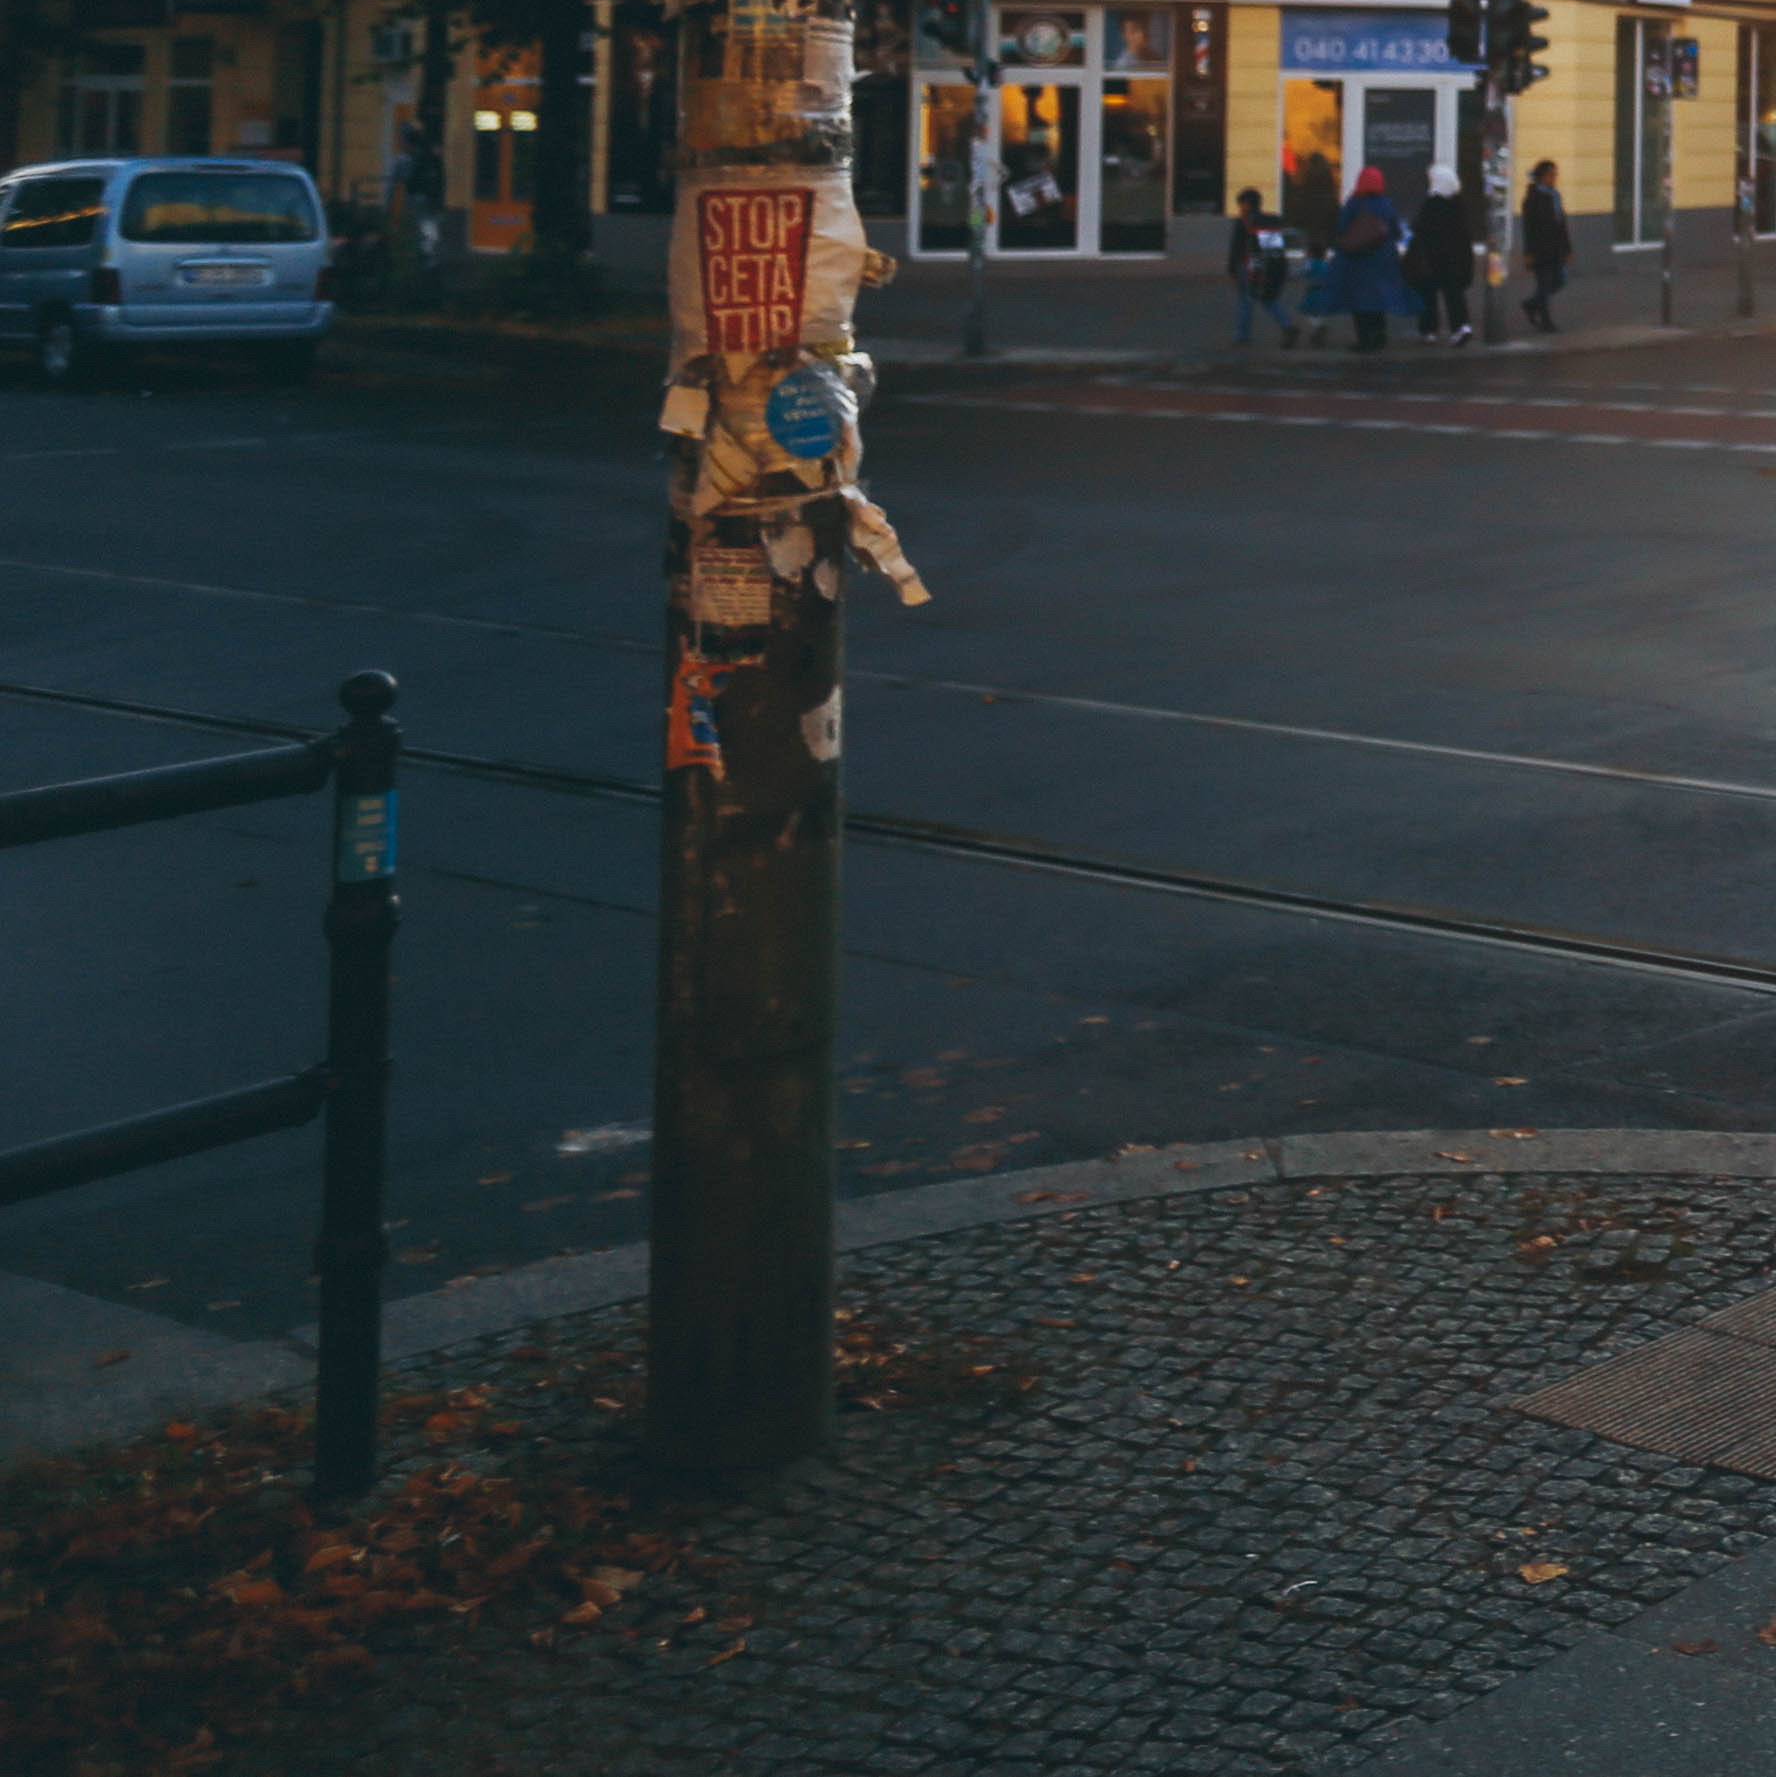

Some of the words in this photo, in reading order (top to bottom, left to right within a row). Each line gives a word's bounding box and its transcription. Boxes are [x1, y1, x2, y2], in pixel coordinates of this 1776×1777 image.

[704, 194, 803, 252] STOP
[707, 253, 796, 306] CETA
[711, 304, 795, 354] TTIP
